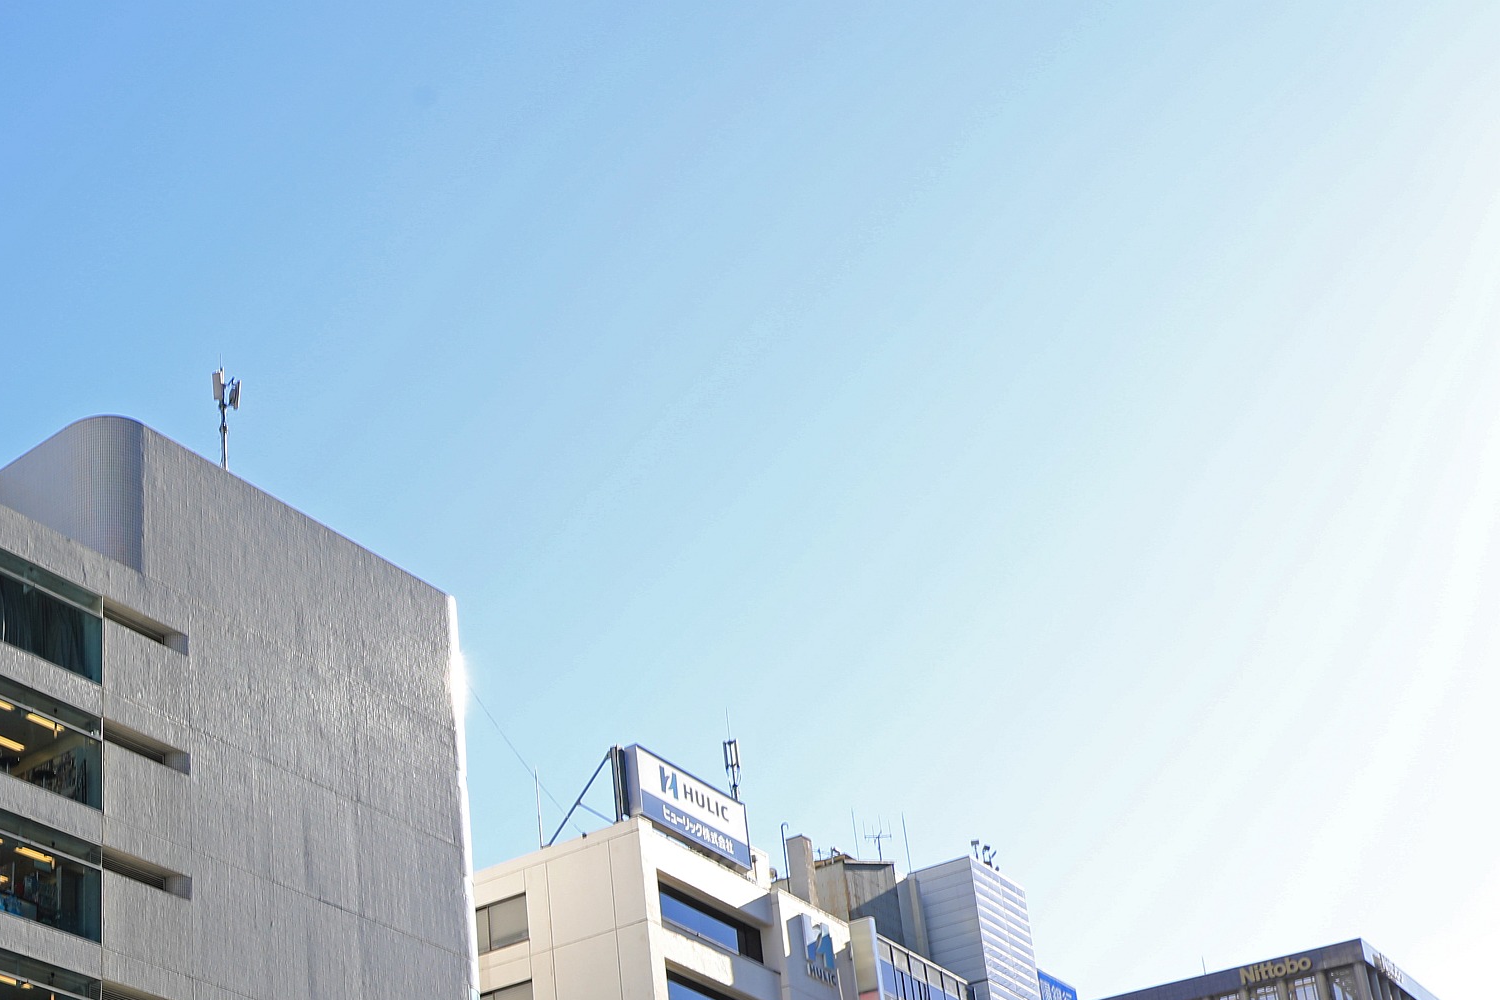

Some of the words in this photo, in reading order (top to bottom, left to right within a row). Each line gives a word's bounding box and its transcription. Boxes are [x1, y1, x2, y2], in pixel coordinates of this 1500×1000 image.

[683, 783, 729, 822] HULIC
[663, 804, 734, 854] ヒューリック株式会社
[1239, 956, 1312, 986] Nittobo
